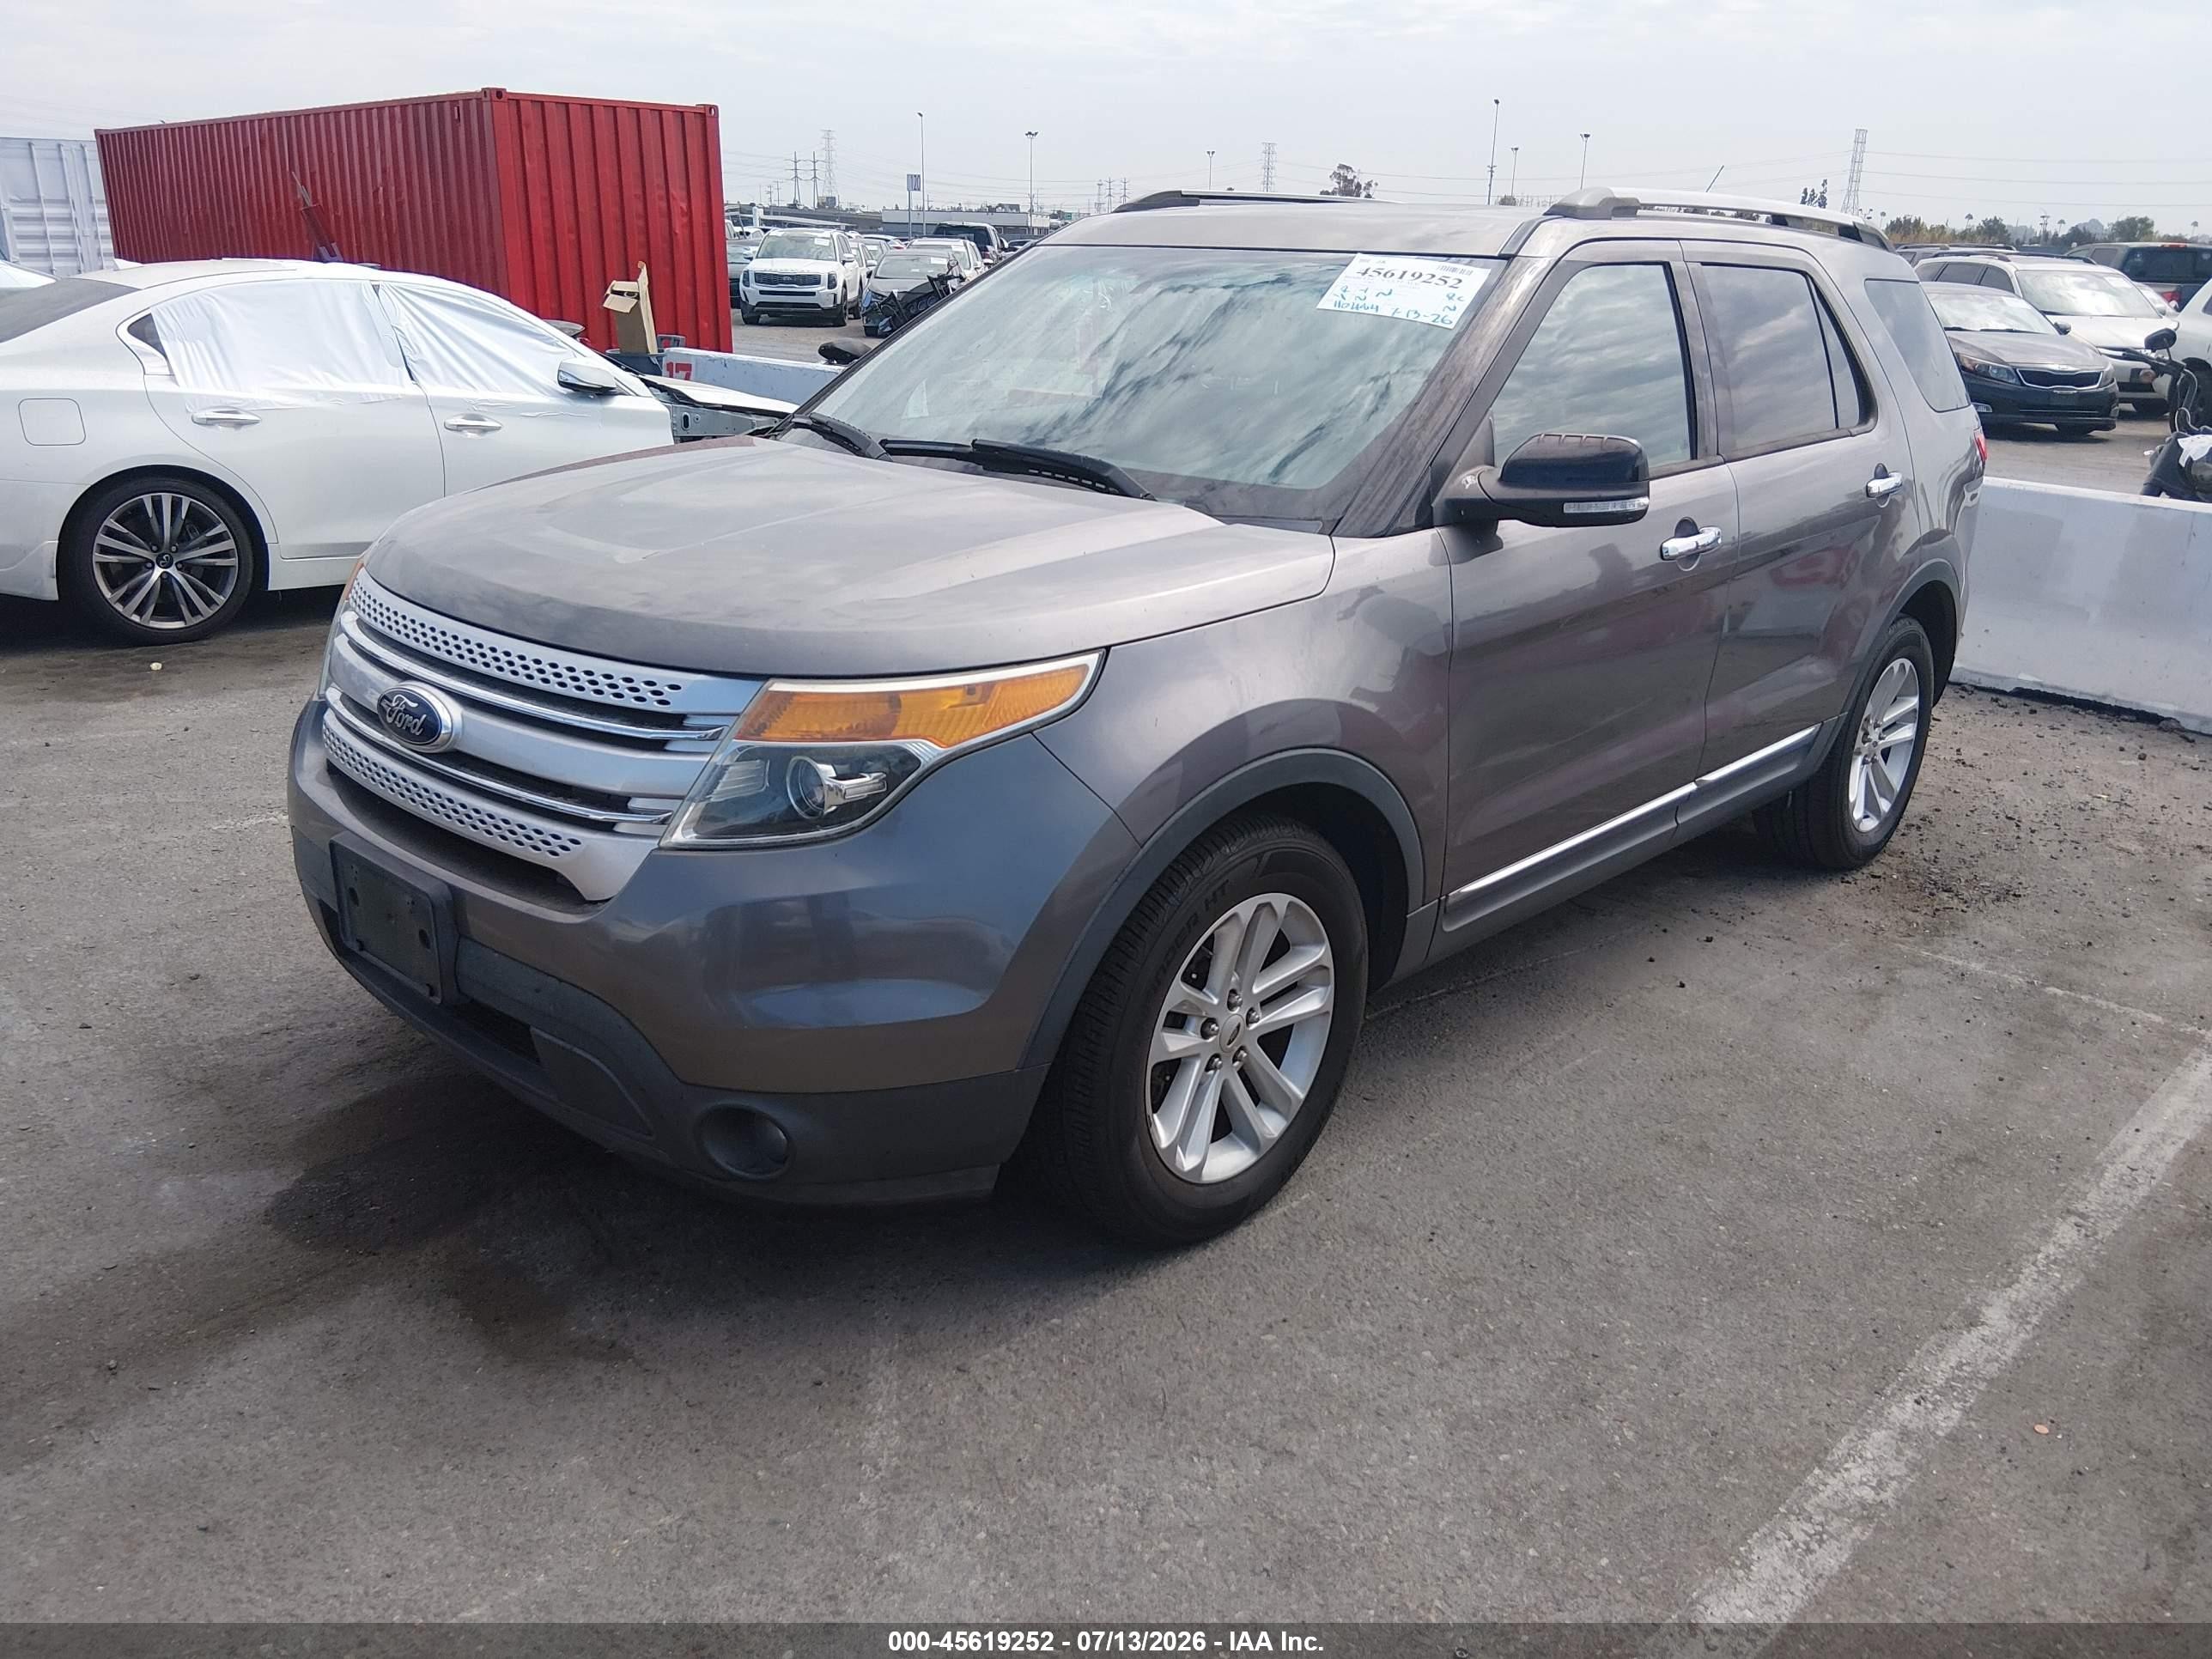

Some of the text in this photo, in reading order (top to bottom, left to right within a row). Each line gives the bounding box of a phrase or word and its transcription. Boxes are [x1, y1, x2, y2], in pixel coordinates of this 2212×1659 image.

[1356, 266, 1463, 289] 45619252
[665, 361, 693, 381] 17
[380, 694, 427, 736] Ford
